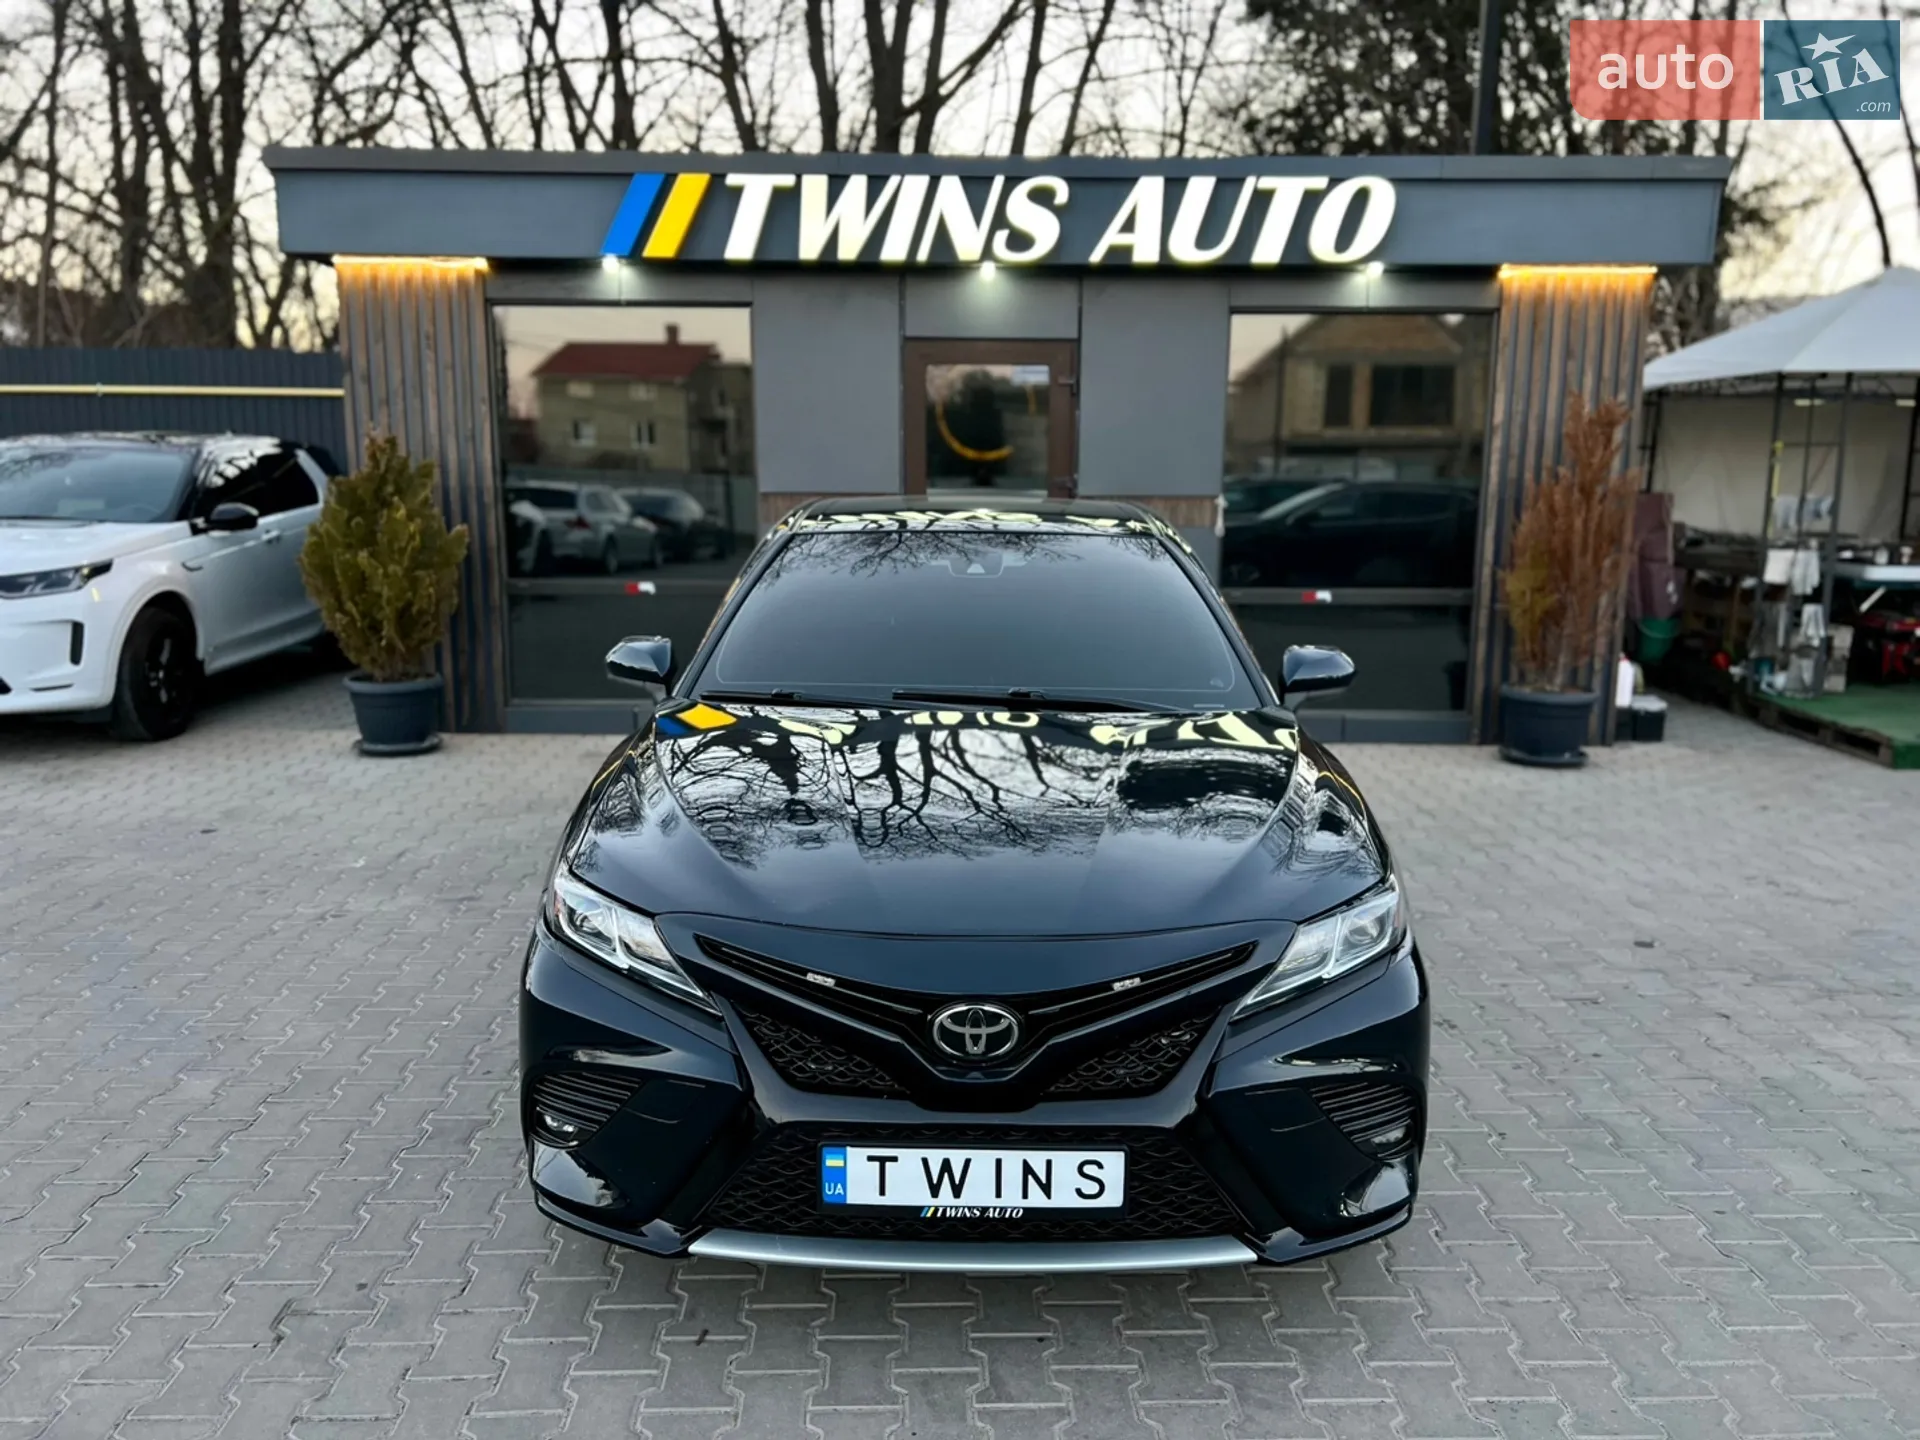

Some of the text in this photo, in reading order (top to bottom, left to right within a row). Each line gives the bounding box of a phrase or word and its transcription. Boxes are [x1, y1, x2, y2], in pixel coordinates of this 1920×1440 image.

[723, 173, 1396, 266] TWINS AUTO
[824, 1182, 845, 1196] UA
[935, 1206, 1024, 1219] TWINS AUTO
